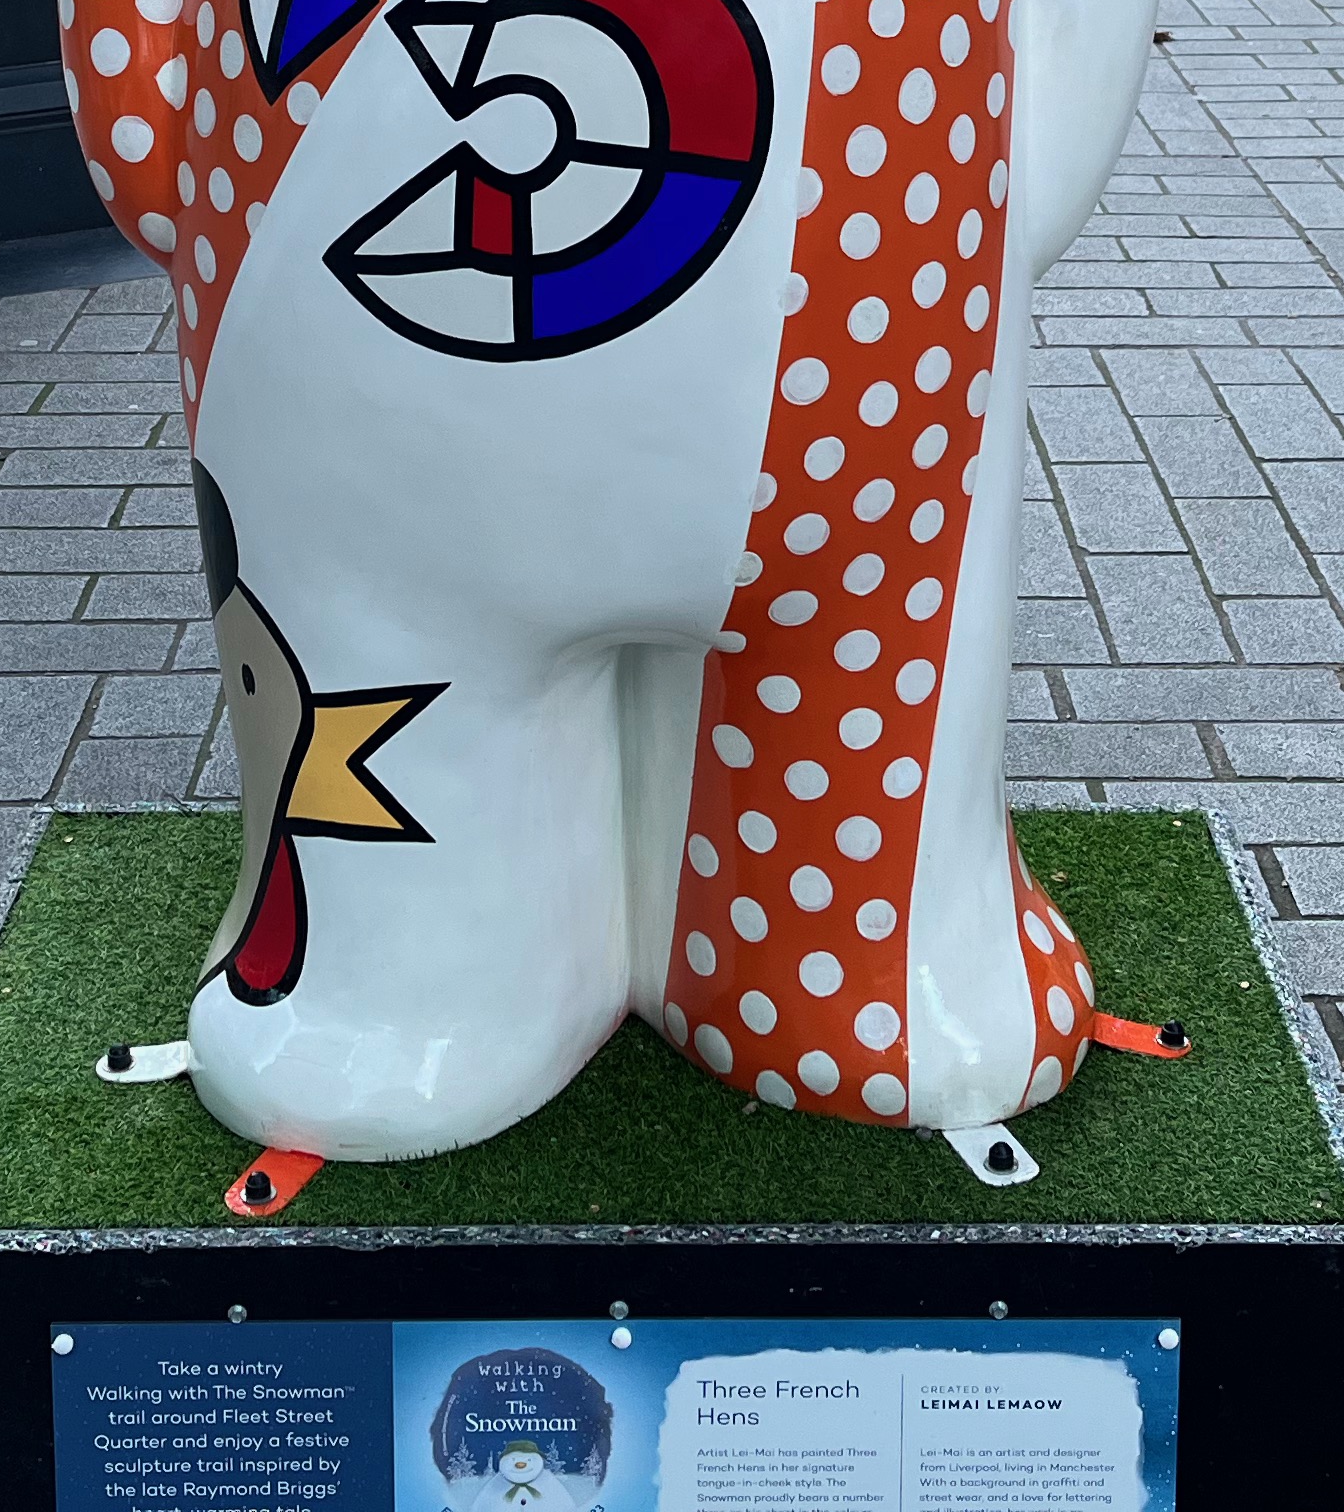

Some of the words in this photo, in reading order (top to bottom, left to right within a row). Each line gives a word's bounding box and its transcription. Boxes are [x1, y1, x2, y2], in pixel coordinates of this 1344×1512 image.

[157, 1361, 201, 1376] Take
[207, 1364, 219, 1375] a
[224, 1360, 283, 1379] wintry
[495, 1378, 544, 1392] with
[696, 1380, 767, 1399] Three
[776, 1380, 859, 1399] French
[920, 1385, 979, 1394] CREATED
[984, 1385, 1000, 1394] BY
[86, 1386, 162, 1404] Walking
[168, 1385, 208, 1400] with
[212, 1385, 247, 1400] The
[506, 1400, 537, 1415] The
[921, 1399, 979, 1410] LEIMAI
[987, 1399, 1063, 1410] LEMAOW
[108, 1410, 146, 1425] trail
[151, 1409, 217, 1425] around
[223, 1409, 270, 1424] Fleet
[275, 1409, 335, 1424] Street
[697, 1407, 759, 1426] Hens
[94, 1434, 167, 1451] Quarter
[172, 1434, 207, 1449] and
[213, 1433, 263, 1451] enjoy
[268, 1436, 280, 1447] a
[285, 1431, 350, 1448] festive
[697, 1448, 729, 1457] Artist
[732, 1448, 775, 1457] Lei-Mai
[778, 1448, 798, 1457] has
[801, 1448, 844, 1459] painted
[846, 1448, 877, 1457] Three
[920, 1448, 963, 1457] Lei-Mai
[966, 1448, 975, 1457] is
[995, 1448, 1025, 1457] artist
[1029, 1448, 1050, 1457] and
[1053, 1448, 1101, 1459] designer
[104, 1458, 192, 1477] sculpture
[196, 1457, 234, 1472] trail
[239, 1456, 312, 1475] inspired
[318, 1456, 341, 1475] by
[697, 1463, 734, 1472] French
[738, 1463, 765, 1472] Hens
[768, 1463, 778, 1472] in
[782, 1463, 799, 1472] her
[802, 1463, 855, 1474] signature
[920, 1463, 946, 1472] from
[949, 1463, 1001, 1474] Liverpool,
[1004, 1463, 1034, 1474] living
[1037, 1463, 1047, 1472] in
[697, 1478, 791, 1489] tongue-in-cheek
[826, 1478, 846, 1487] The
[919, 1478, 946, 1487] With
[960, 1478, 1025, 1489] background
[1028, 1478, 1039, 1487] in
[1042, 1478, 1080, 1489] graffiti
[1083, 1478, 1105, 1487] and
[105, 1482, 136, 1497] the
[142, 1482, 177, 1497] late
[184, 1481, 271, 1500] Raymond
[697, 1493, 751, 1502] Snowman
[754, 1493, 796, 1504] proudly
[798, 1493, 829, 1502] bears
[842, 1493, 885, 1502] number
[919, 1493, 952, 1502] street
[987, 1493, 1008, 1502] and
[1021, 1493, 1044, 1502] love
[1047, 1493, 1063, 1502] for
[1065, 1493, 1112, 1504] lettering
